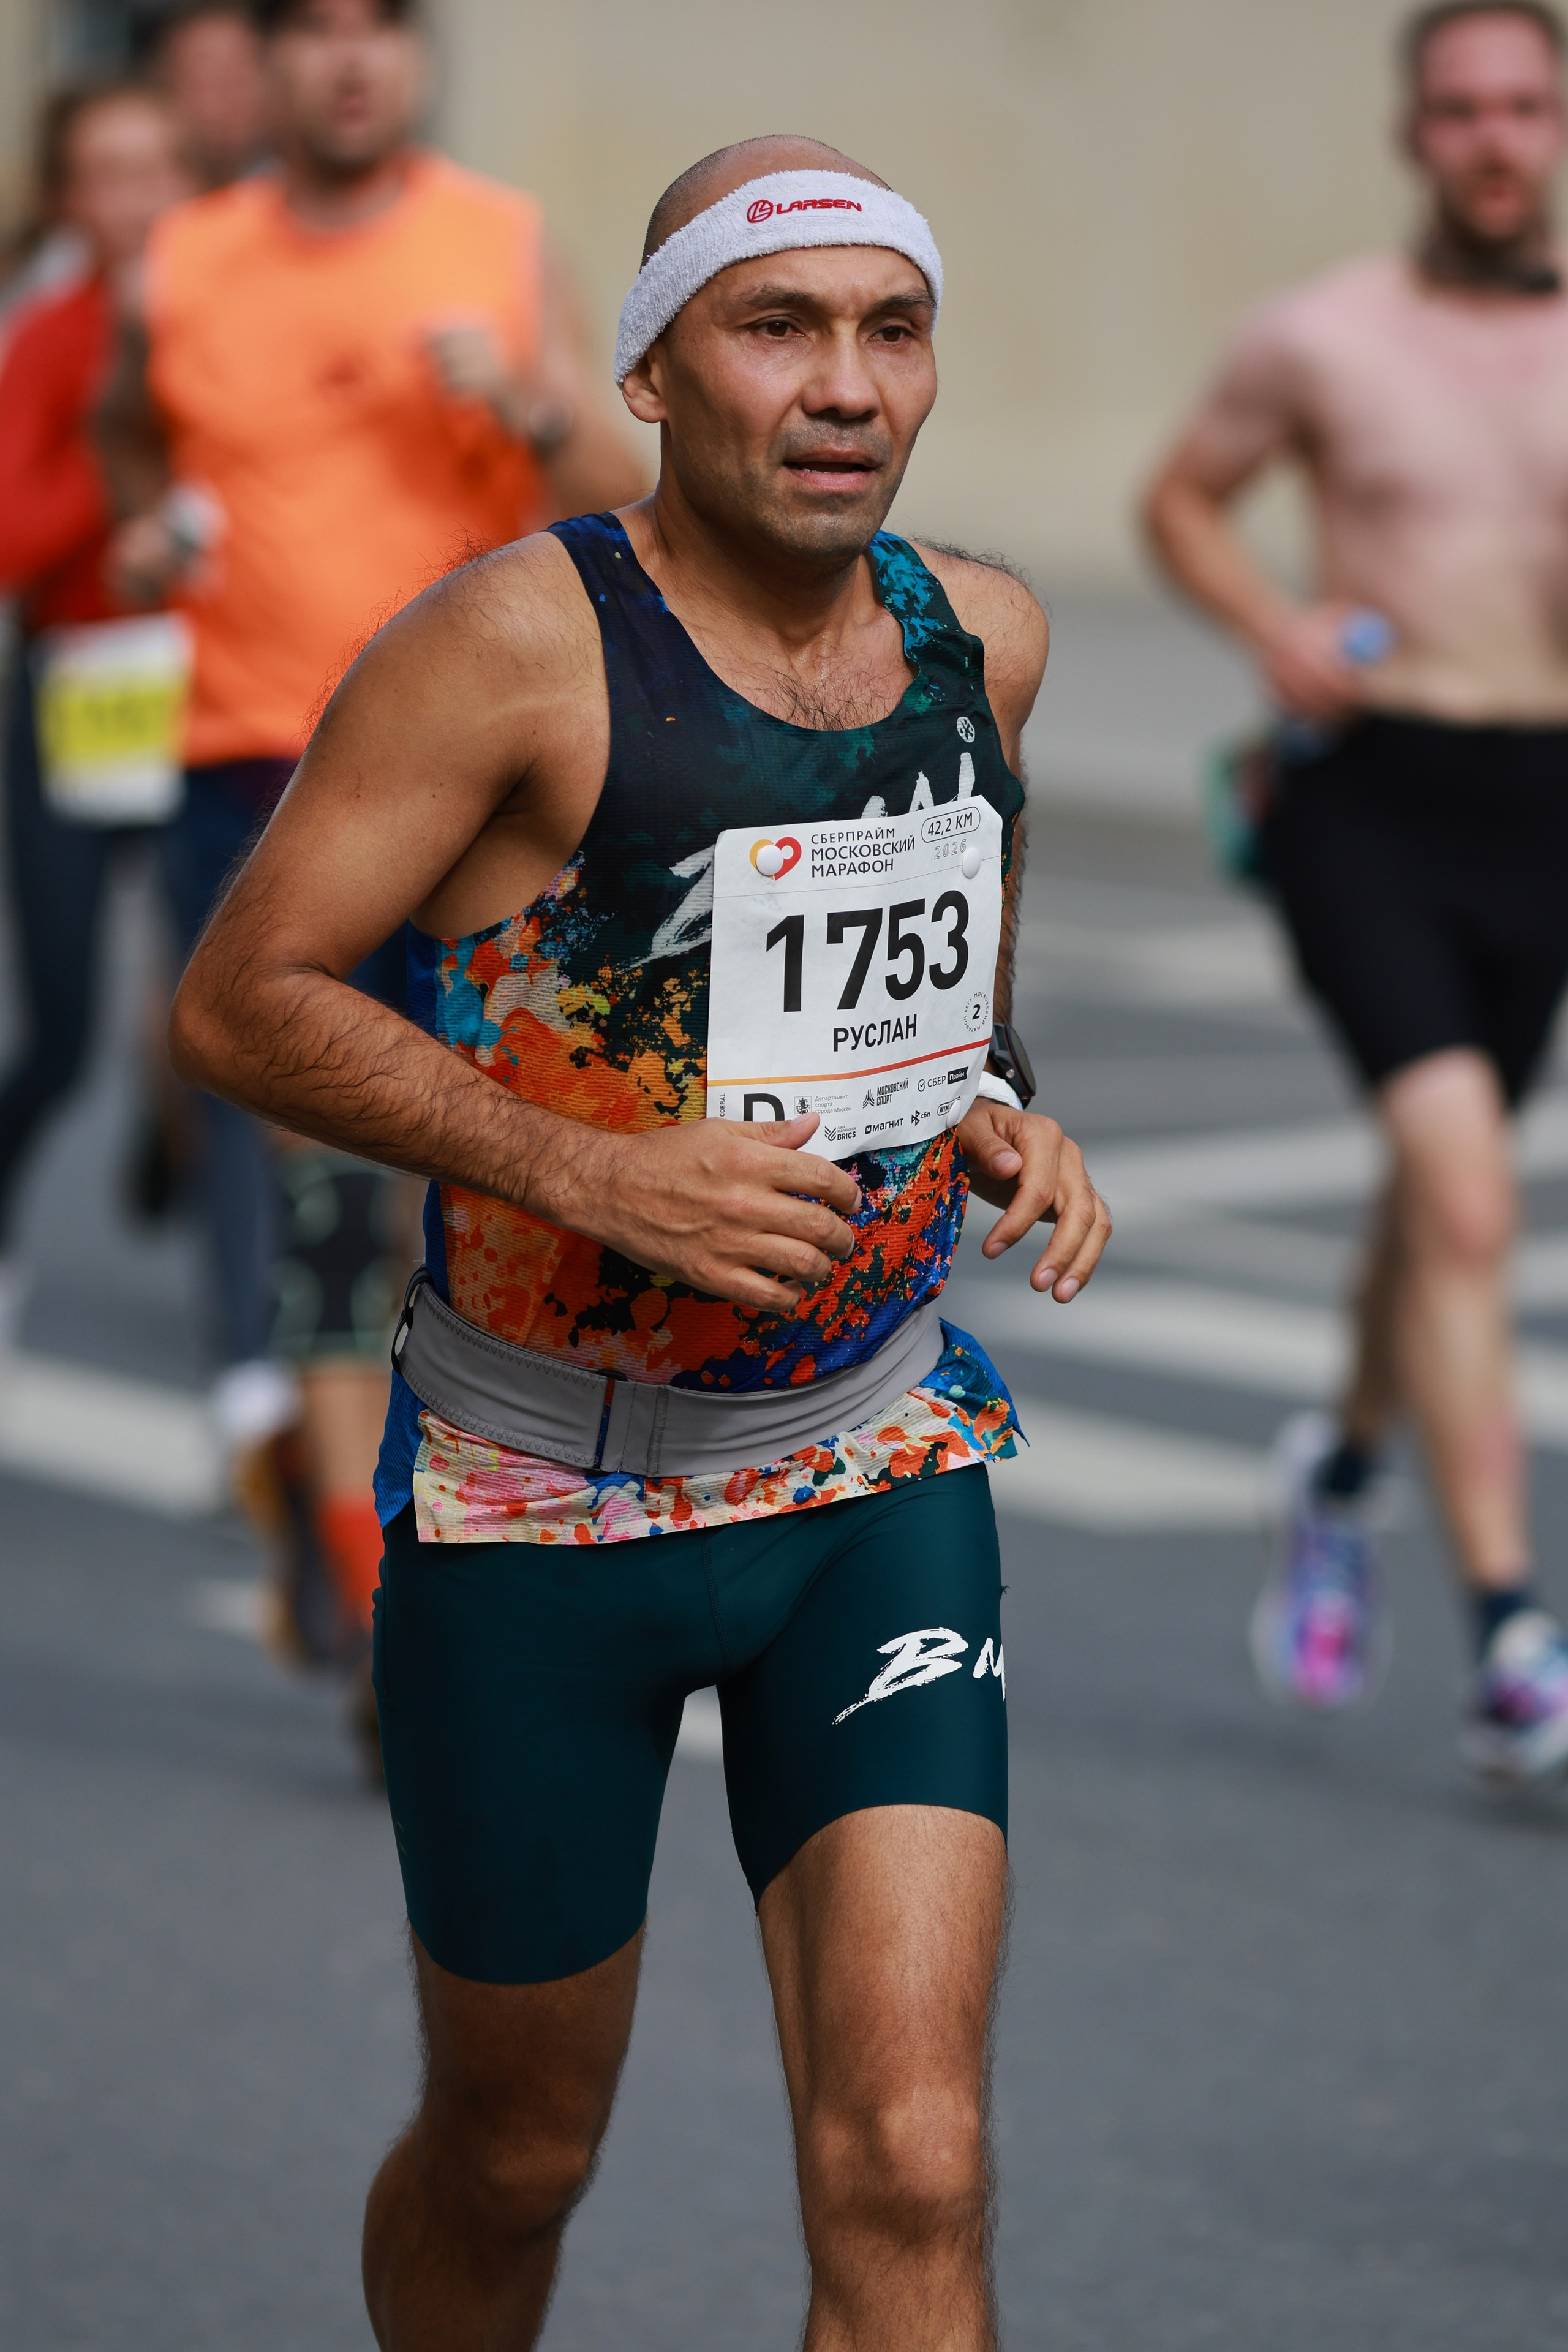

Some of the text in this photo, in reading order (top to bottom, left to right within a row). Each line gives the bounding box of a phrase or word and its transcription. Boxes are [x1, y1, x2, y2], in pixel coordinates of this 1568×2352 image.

[776, 199, 862, 214] LARSEN
[811, 827, 895, 845] СБЕРПРАЙМ
[927, 818, 951, 836] 42,2
[811, 835, 915, 862] МОСКОВСКИЙ
[933, 839, 967, 860] 2026
[812, 858, 894, 878] МАРАФОН
[766, 890, 970, 1013] 1753
[972, 1005, 981, 1020] 2
[833, 1014, 918, 1052] РУСЛАН
[876, 1078, 909, 1096] МОСКОВСКИЙ
[927, 1071, 965, 1088] СБЕР Прайм
[876, 1094, 892, 1106] СПОРТ
[837, 1131, 856, 1140] BRICS
